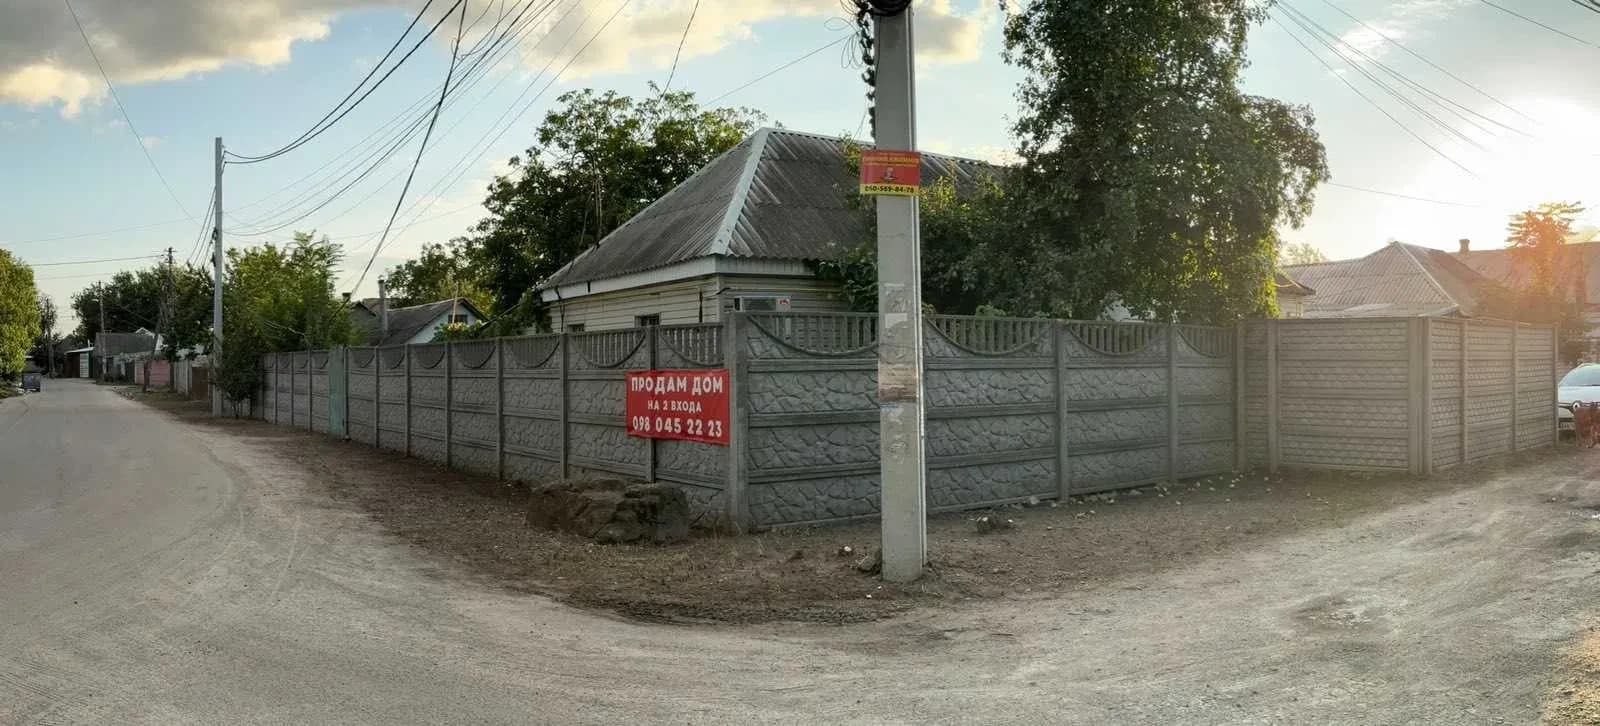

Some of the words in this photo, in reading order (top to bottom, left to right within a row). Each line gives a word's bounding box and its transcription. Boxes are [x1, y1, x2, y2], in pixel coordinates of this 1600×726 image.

[631, 376, 687, 394] ПРОДАМ
[692, 376, 723, 395] ДОМ
[648, 400, 659, 410] НА
[663, 400, 668, 410] 2
[671, 401, 702, 413] ВХОДА
[632, 416, 650, 432] 098
[655, 417, 681, 433] 045
[687, 418, 703, 435] 22
[708, 420, 722, 437] 23
